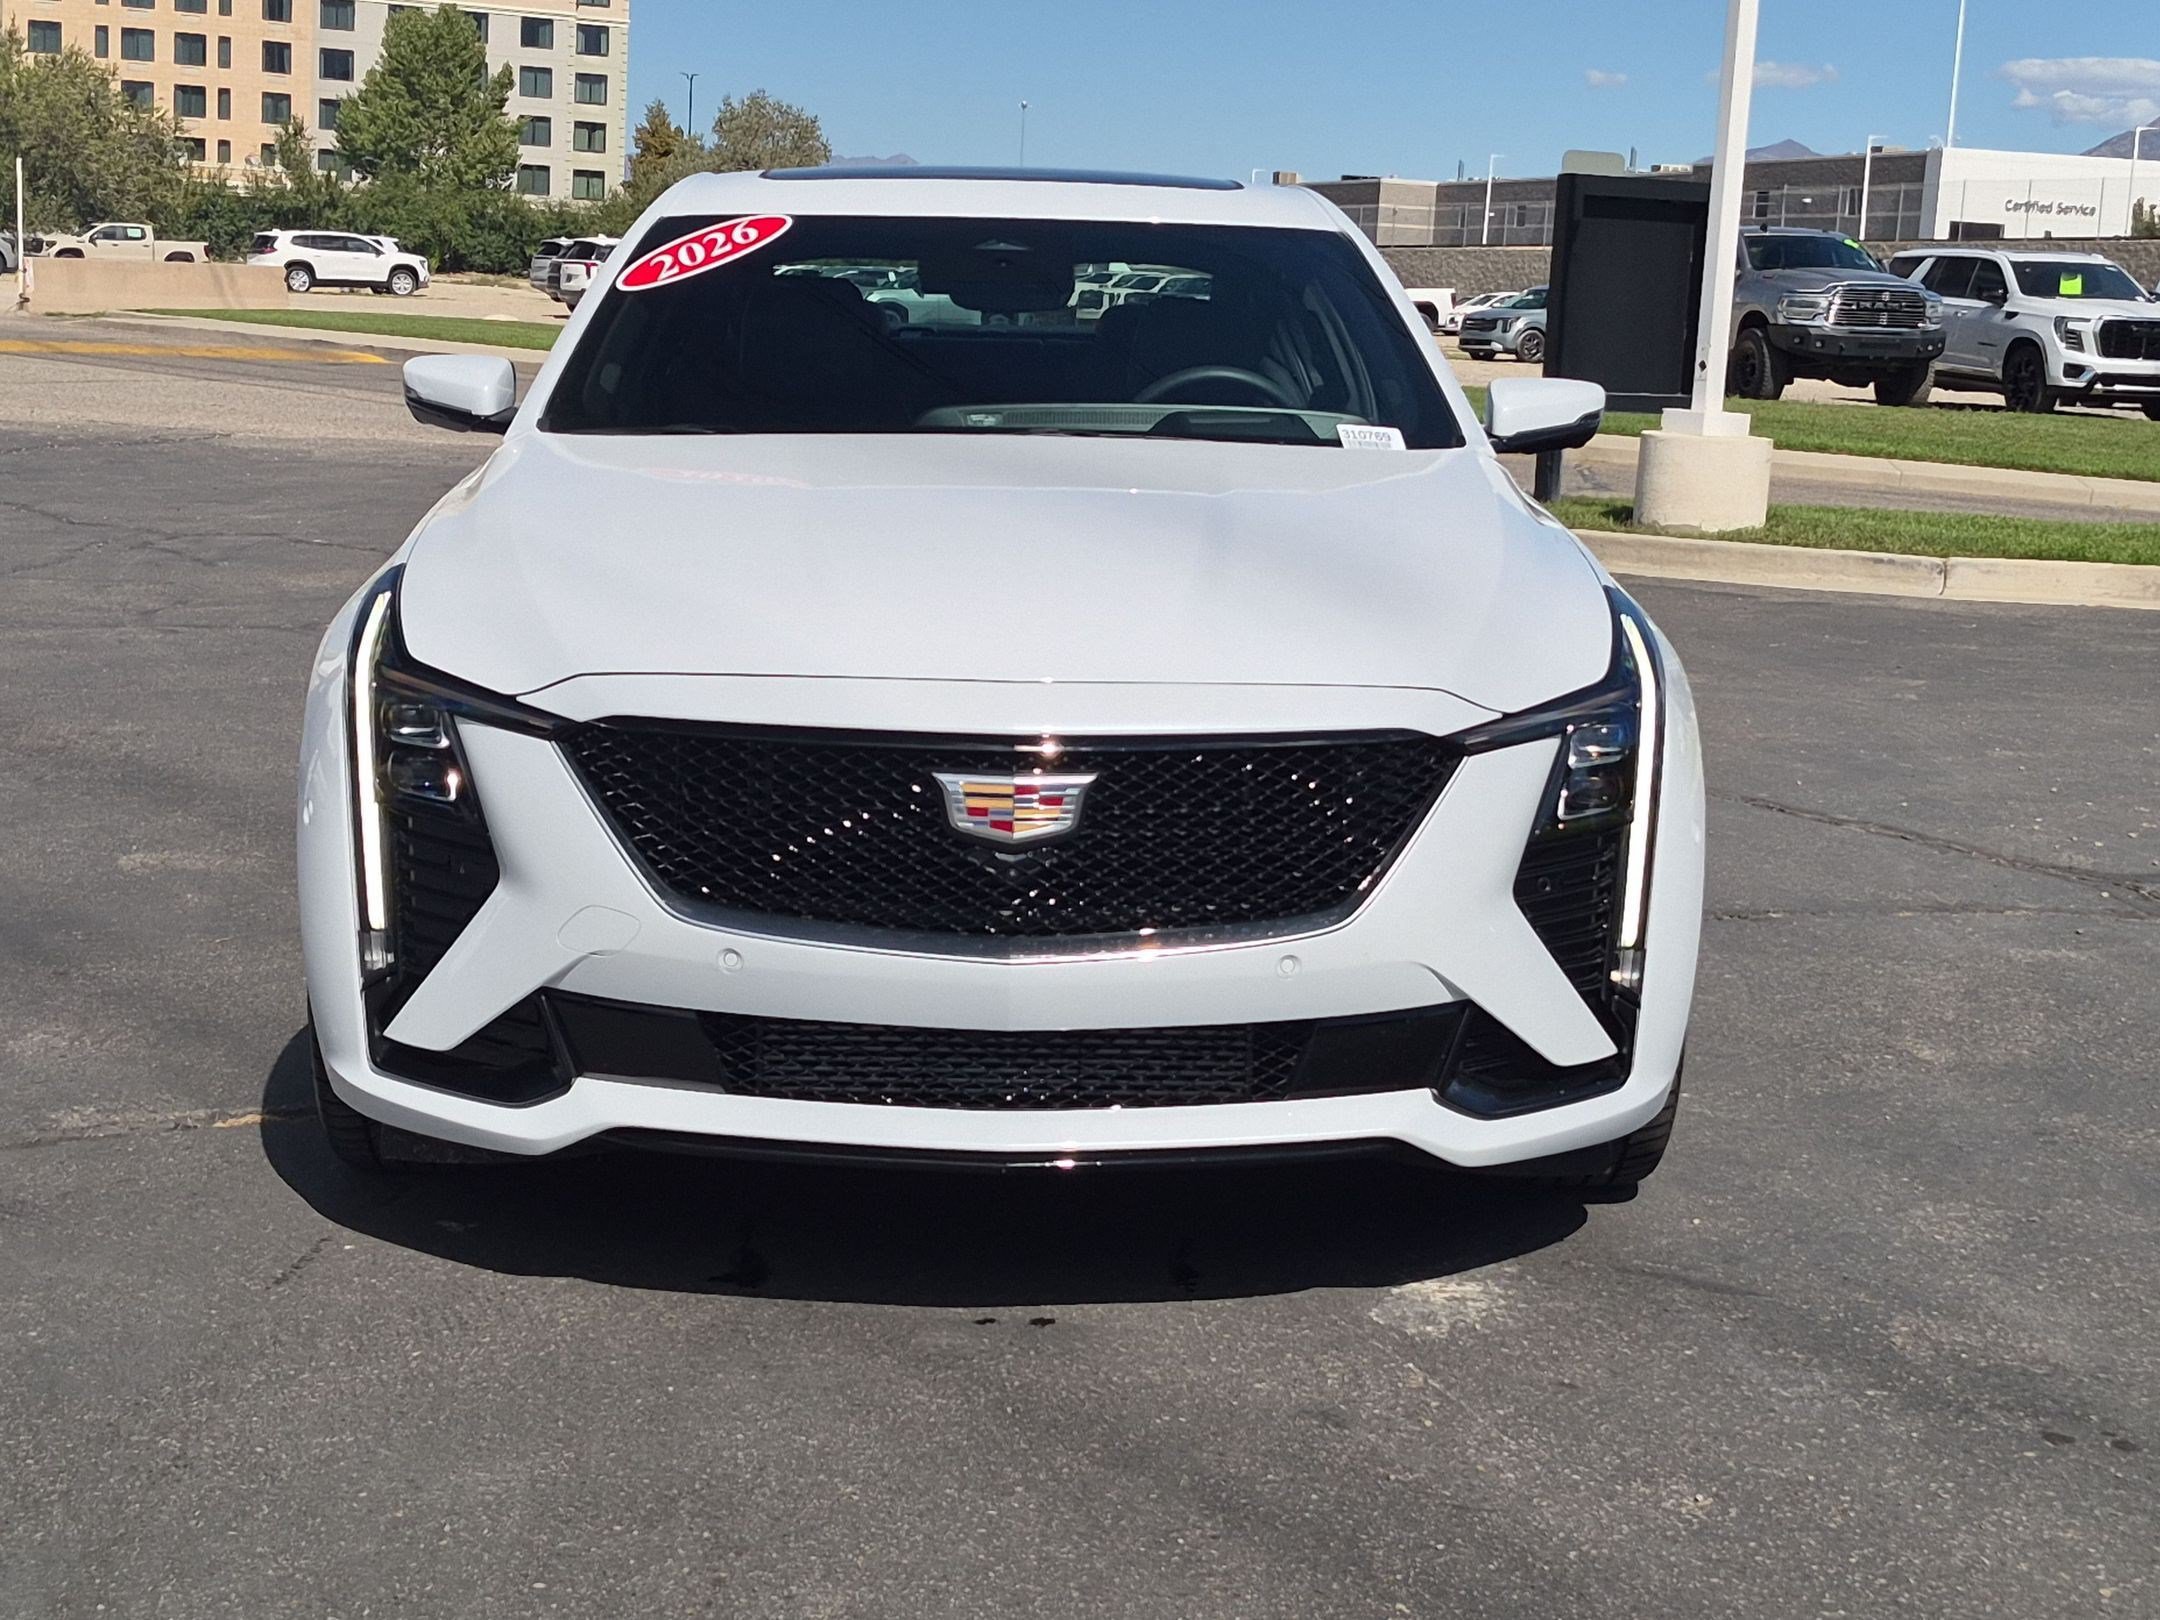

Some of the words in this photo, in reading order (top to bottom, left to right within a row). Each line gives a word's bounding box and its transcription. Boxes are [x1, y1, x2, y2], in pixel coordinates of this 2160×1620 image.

[2005, 199, 2053, 214] Certified
[2056, 202, 2096, 216] Service
[650, 220, 759, 282] 2026
[1858, 301, 1903, 311] RAM
